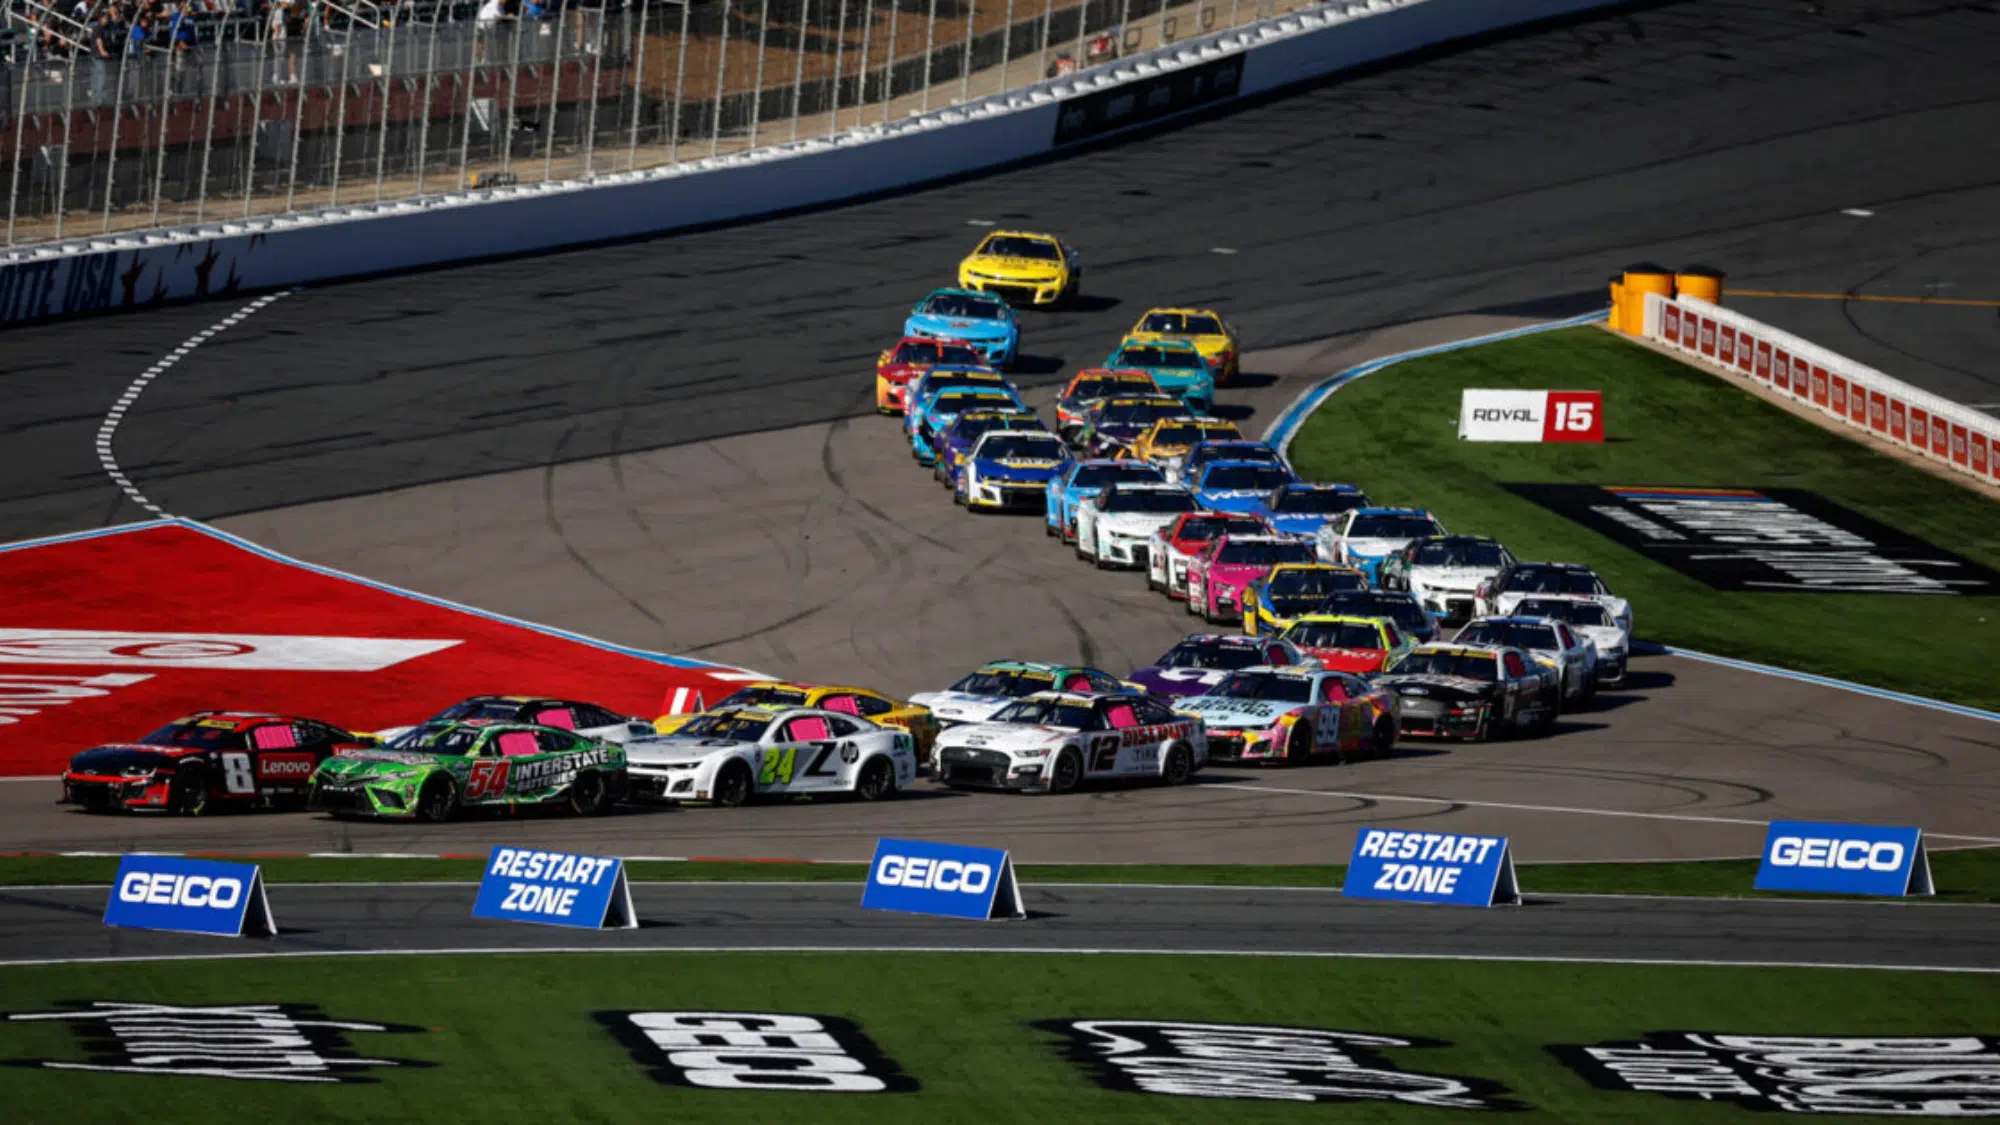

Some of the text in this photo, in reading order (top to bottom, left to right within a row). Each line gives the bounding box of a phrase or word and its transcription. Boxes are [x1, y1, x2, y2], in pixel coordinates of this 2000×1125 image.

[64, 252, 118, 313] USA
[1554, 402, 1593, 431] 15
[1316, 705, 1341, 745] 99
[261, 759, 311, 775] Lenovo
[515, 748, 609, 782] INTERSTATE
[759, 747, 797, 785] 24
[1088, 736, 1120, 772] 12
[222, 753, 255, 793] 8
[463, 759, 512, 799] 54
[1360, 830, 1498, 865] RESTART
[1770, 836, 1905, 873] GEICO
[490, 848, 613, 885] RESTART
[876, 855, 992, 895] GEICO
[1373, 863, 1463, 896] ZONE
[119, 871, 242, 910] GEICO
[501, 882, 580, 917] ZONE
[627, 1012, 887, 1092] GEICO
